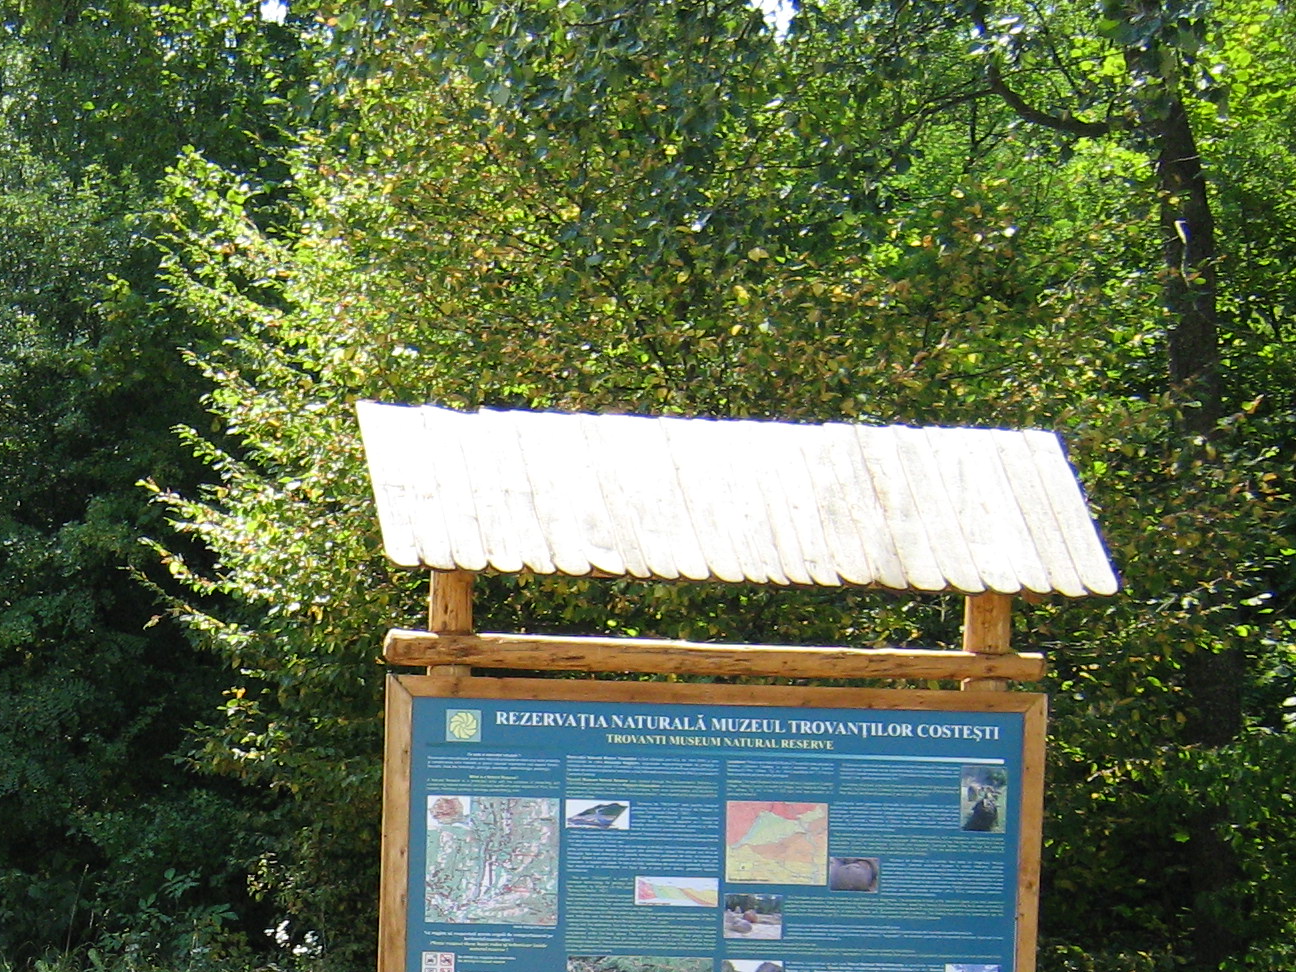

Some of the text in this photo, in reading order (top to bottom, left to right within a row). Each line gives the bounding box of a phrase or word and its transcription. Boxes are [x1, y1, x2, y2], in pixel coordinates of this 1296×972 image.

[611, 714, 707, 731] NATURALĂ
[711, 718, 785, 733] MUZEUL
[606, 733, 834, 750] TROVANTI MUSEUM NATURAL RESERVE
